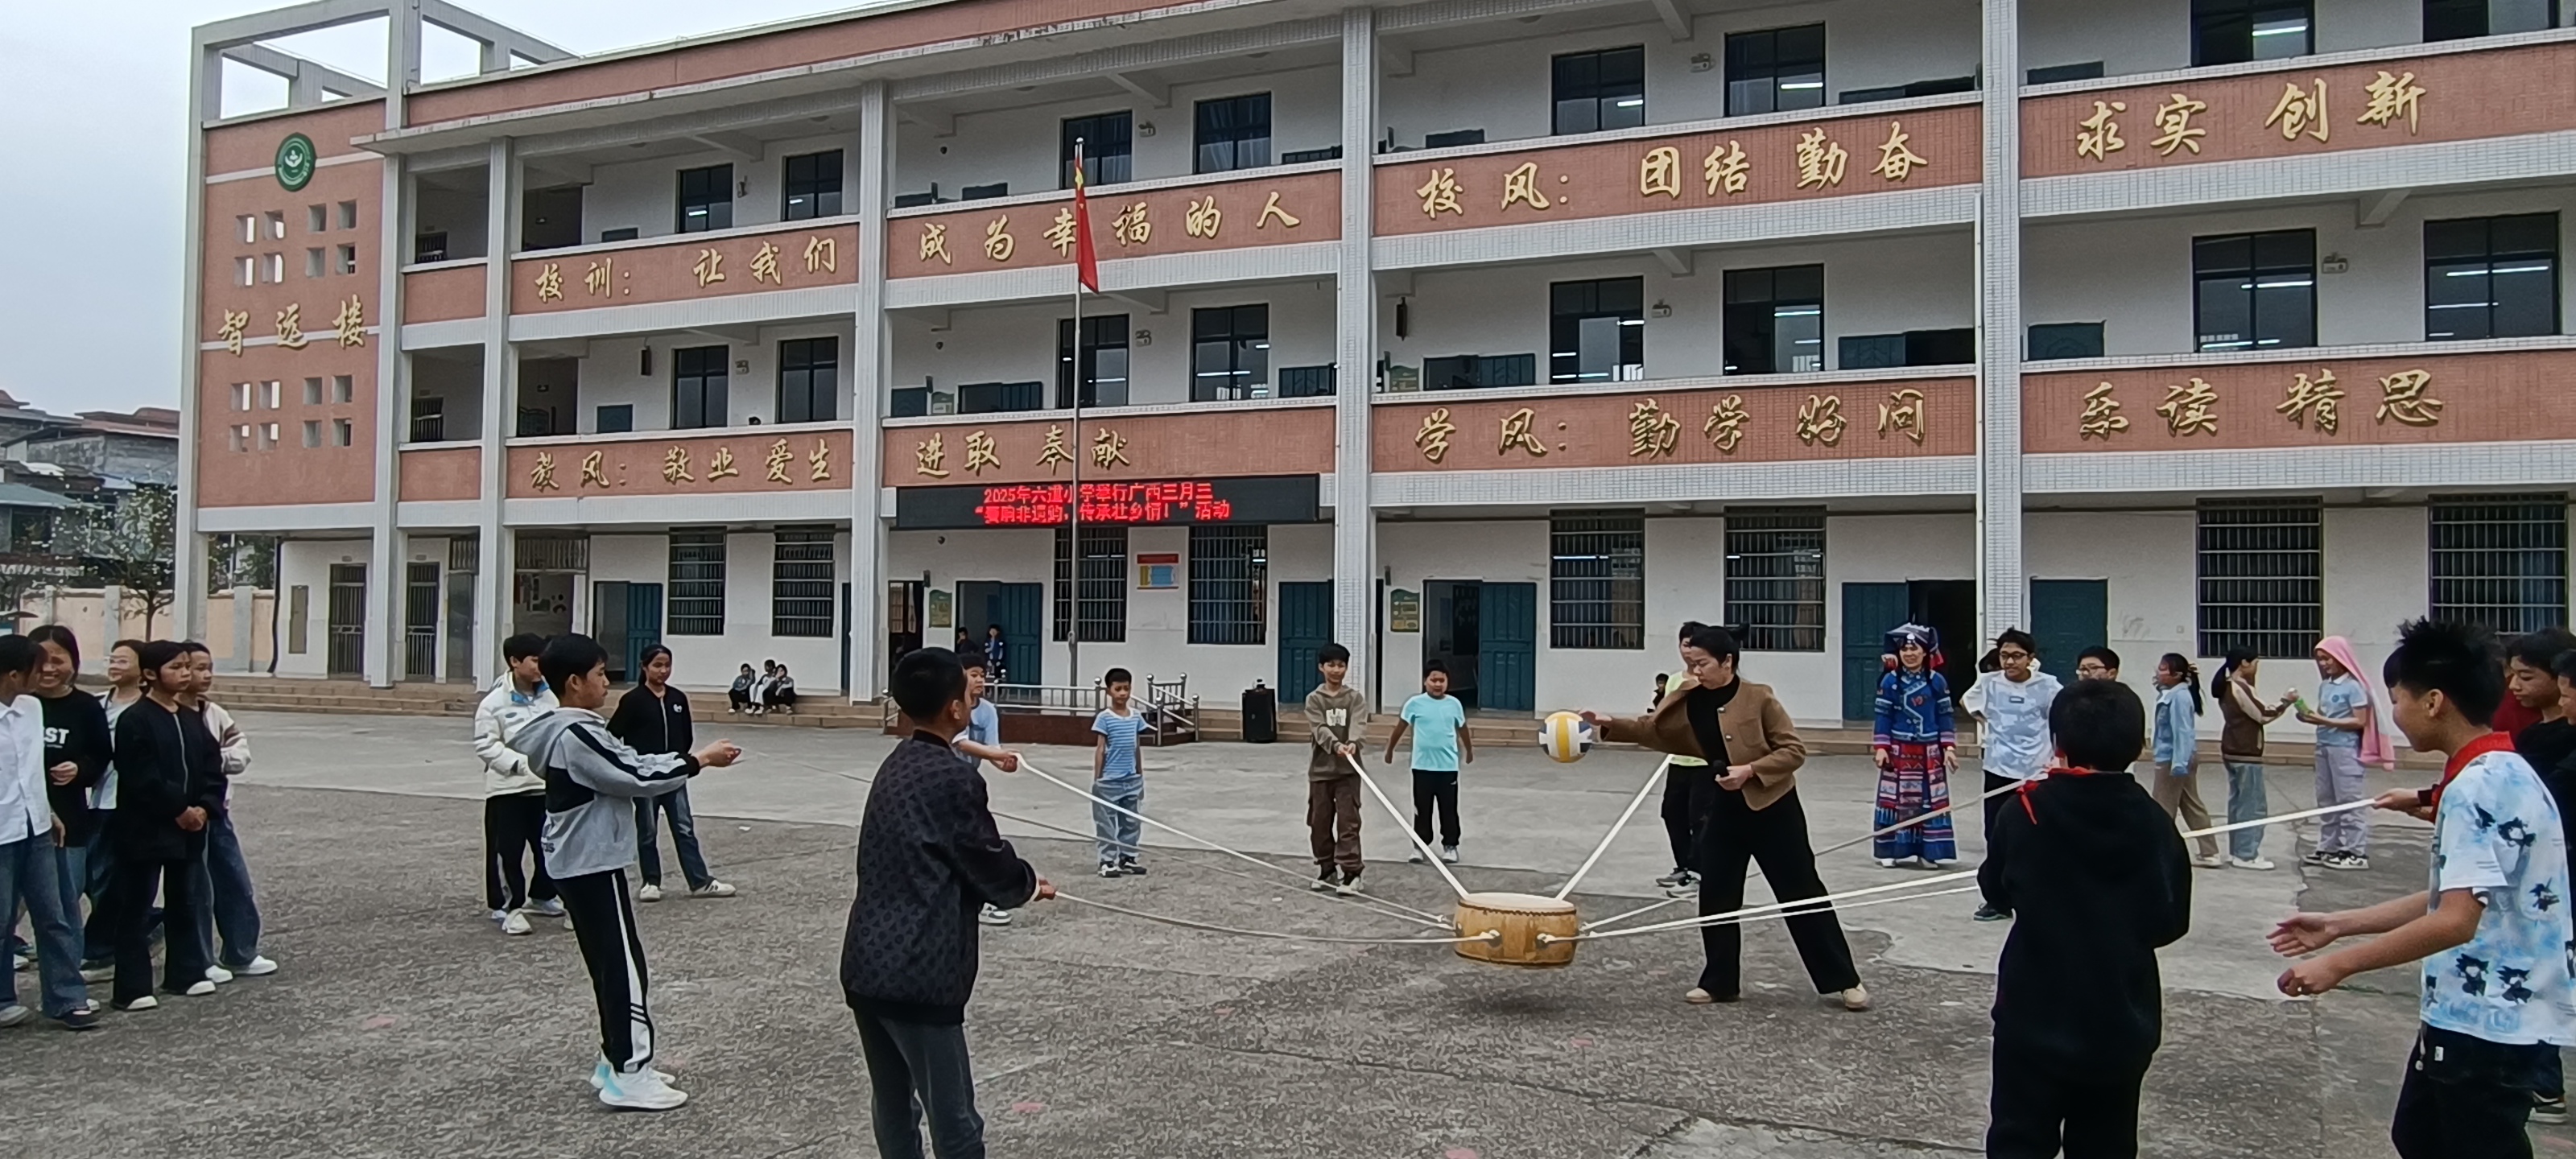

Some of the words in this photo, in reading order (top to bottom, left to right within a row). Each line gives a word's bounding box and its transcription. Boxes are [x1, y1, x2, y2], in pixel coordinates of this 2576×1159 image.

[919, 191, 1301, 265] 成为幸福的人
[217, 293, 368, 356] 智远楼
